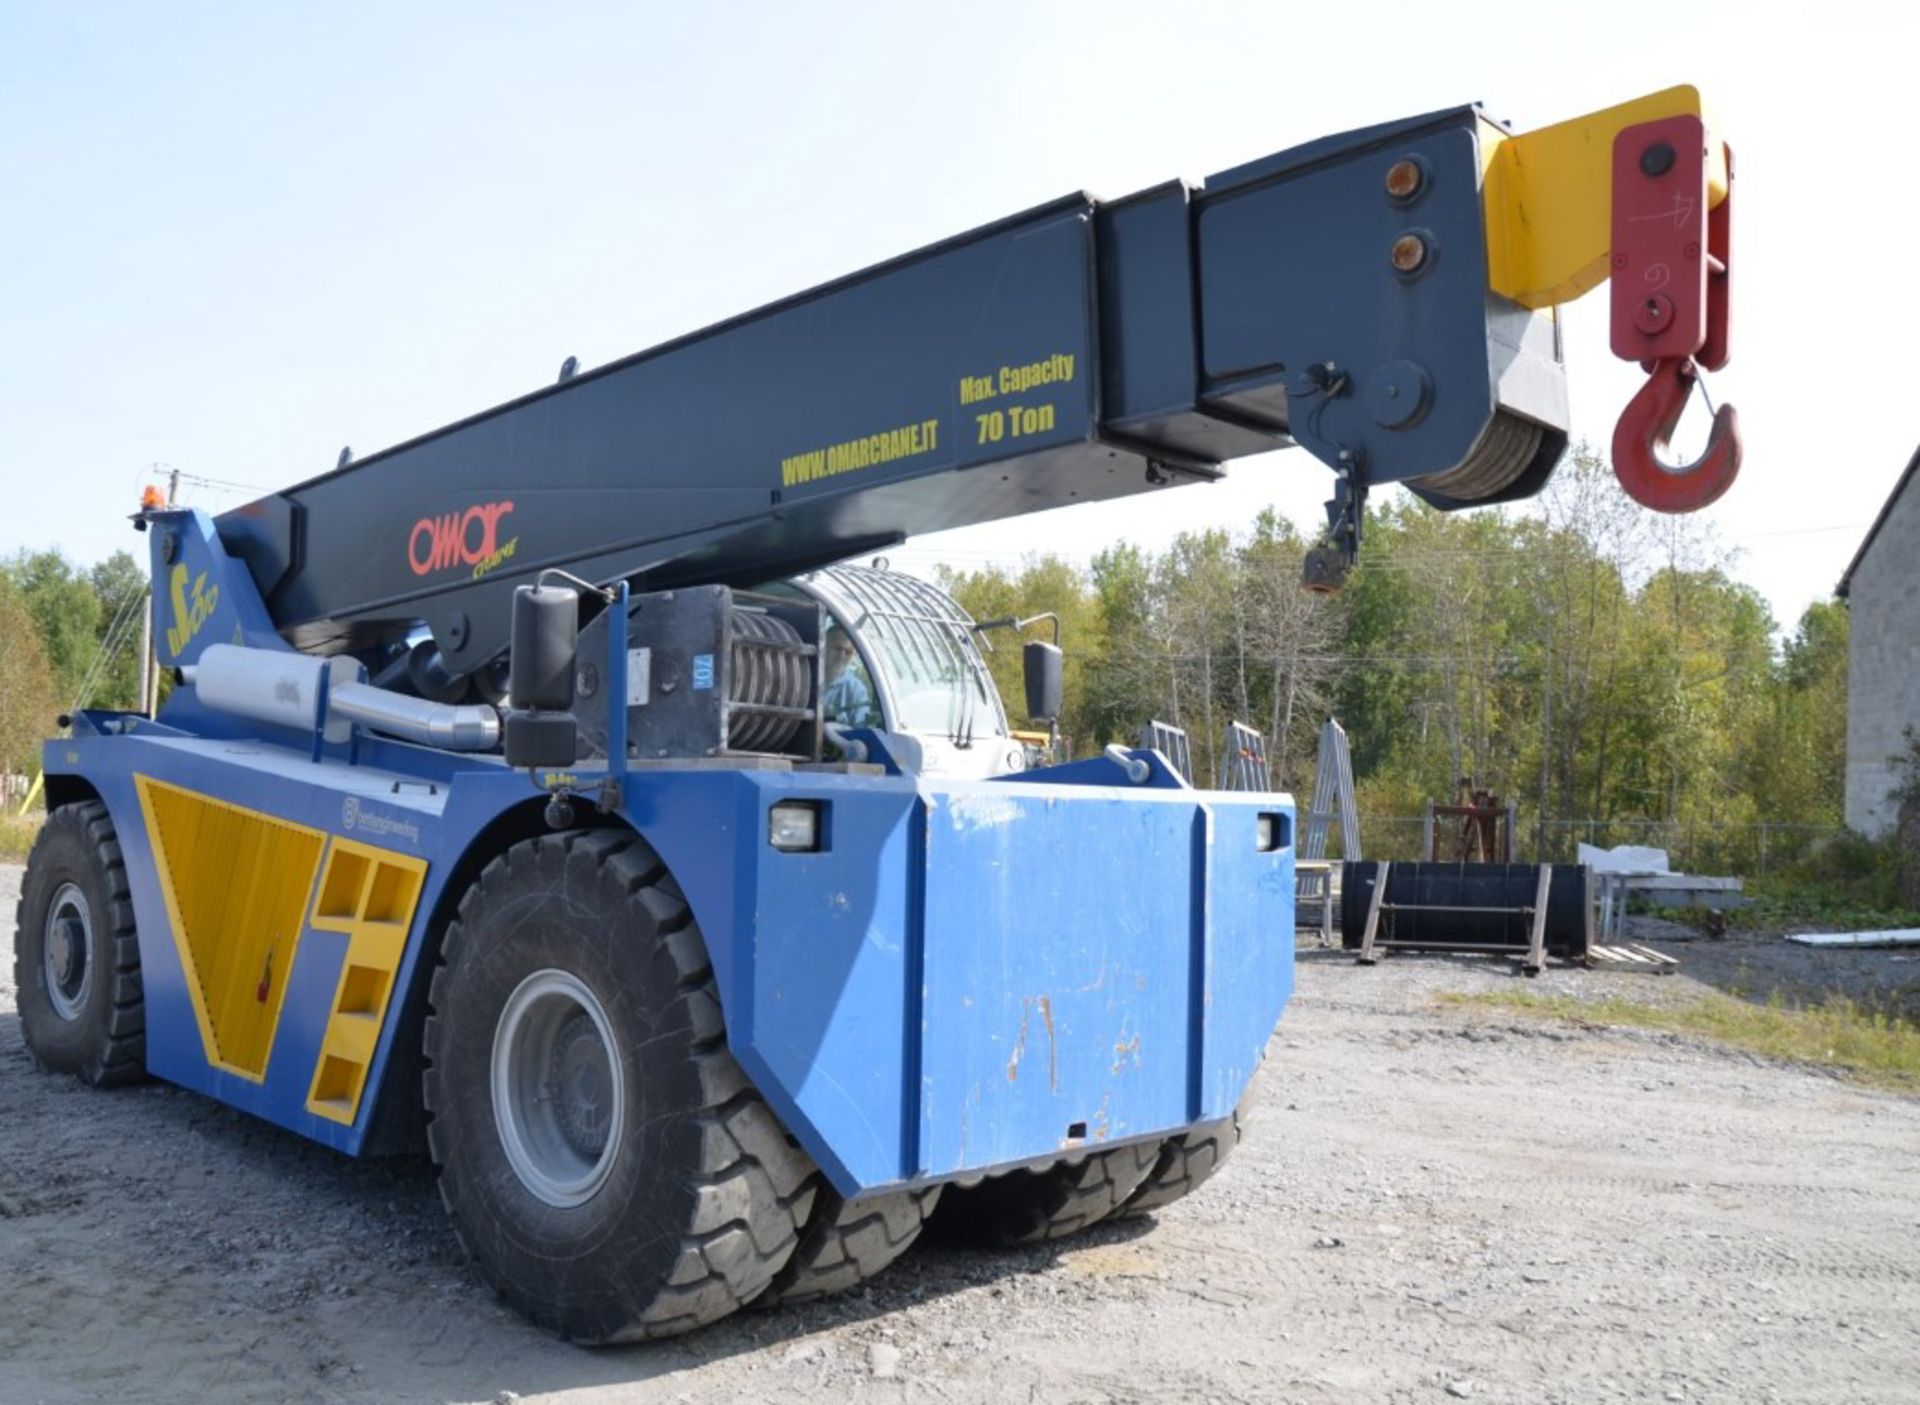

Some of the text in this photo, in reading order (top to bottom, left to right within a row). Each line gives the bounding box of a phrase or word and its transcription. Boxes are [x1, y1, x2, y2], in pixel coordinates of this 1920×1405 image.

[960, 354, 1074, 405] Max. Capacity
[976, 404, 1054, 444] 70 Ton
[782, 419, 938, 486] WWW.OMARCRANE.IT
